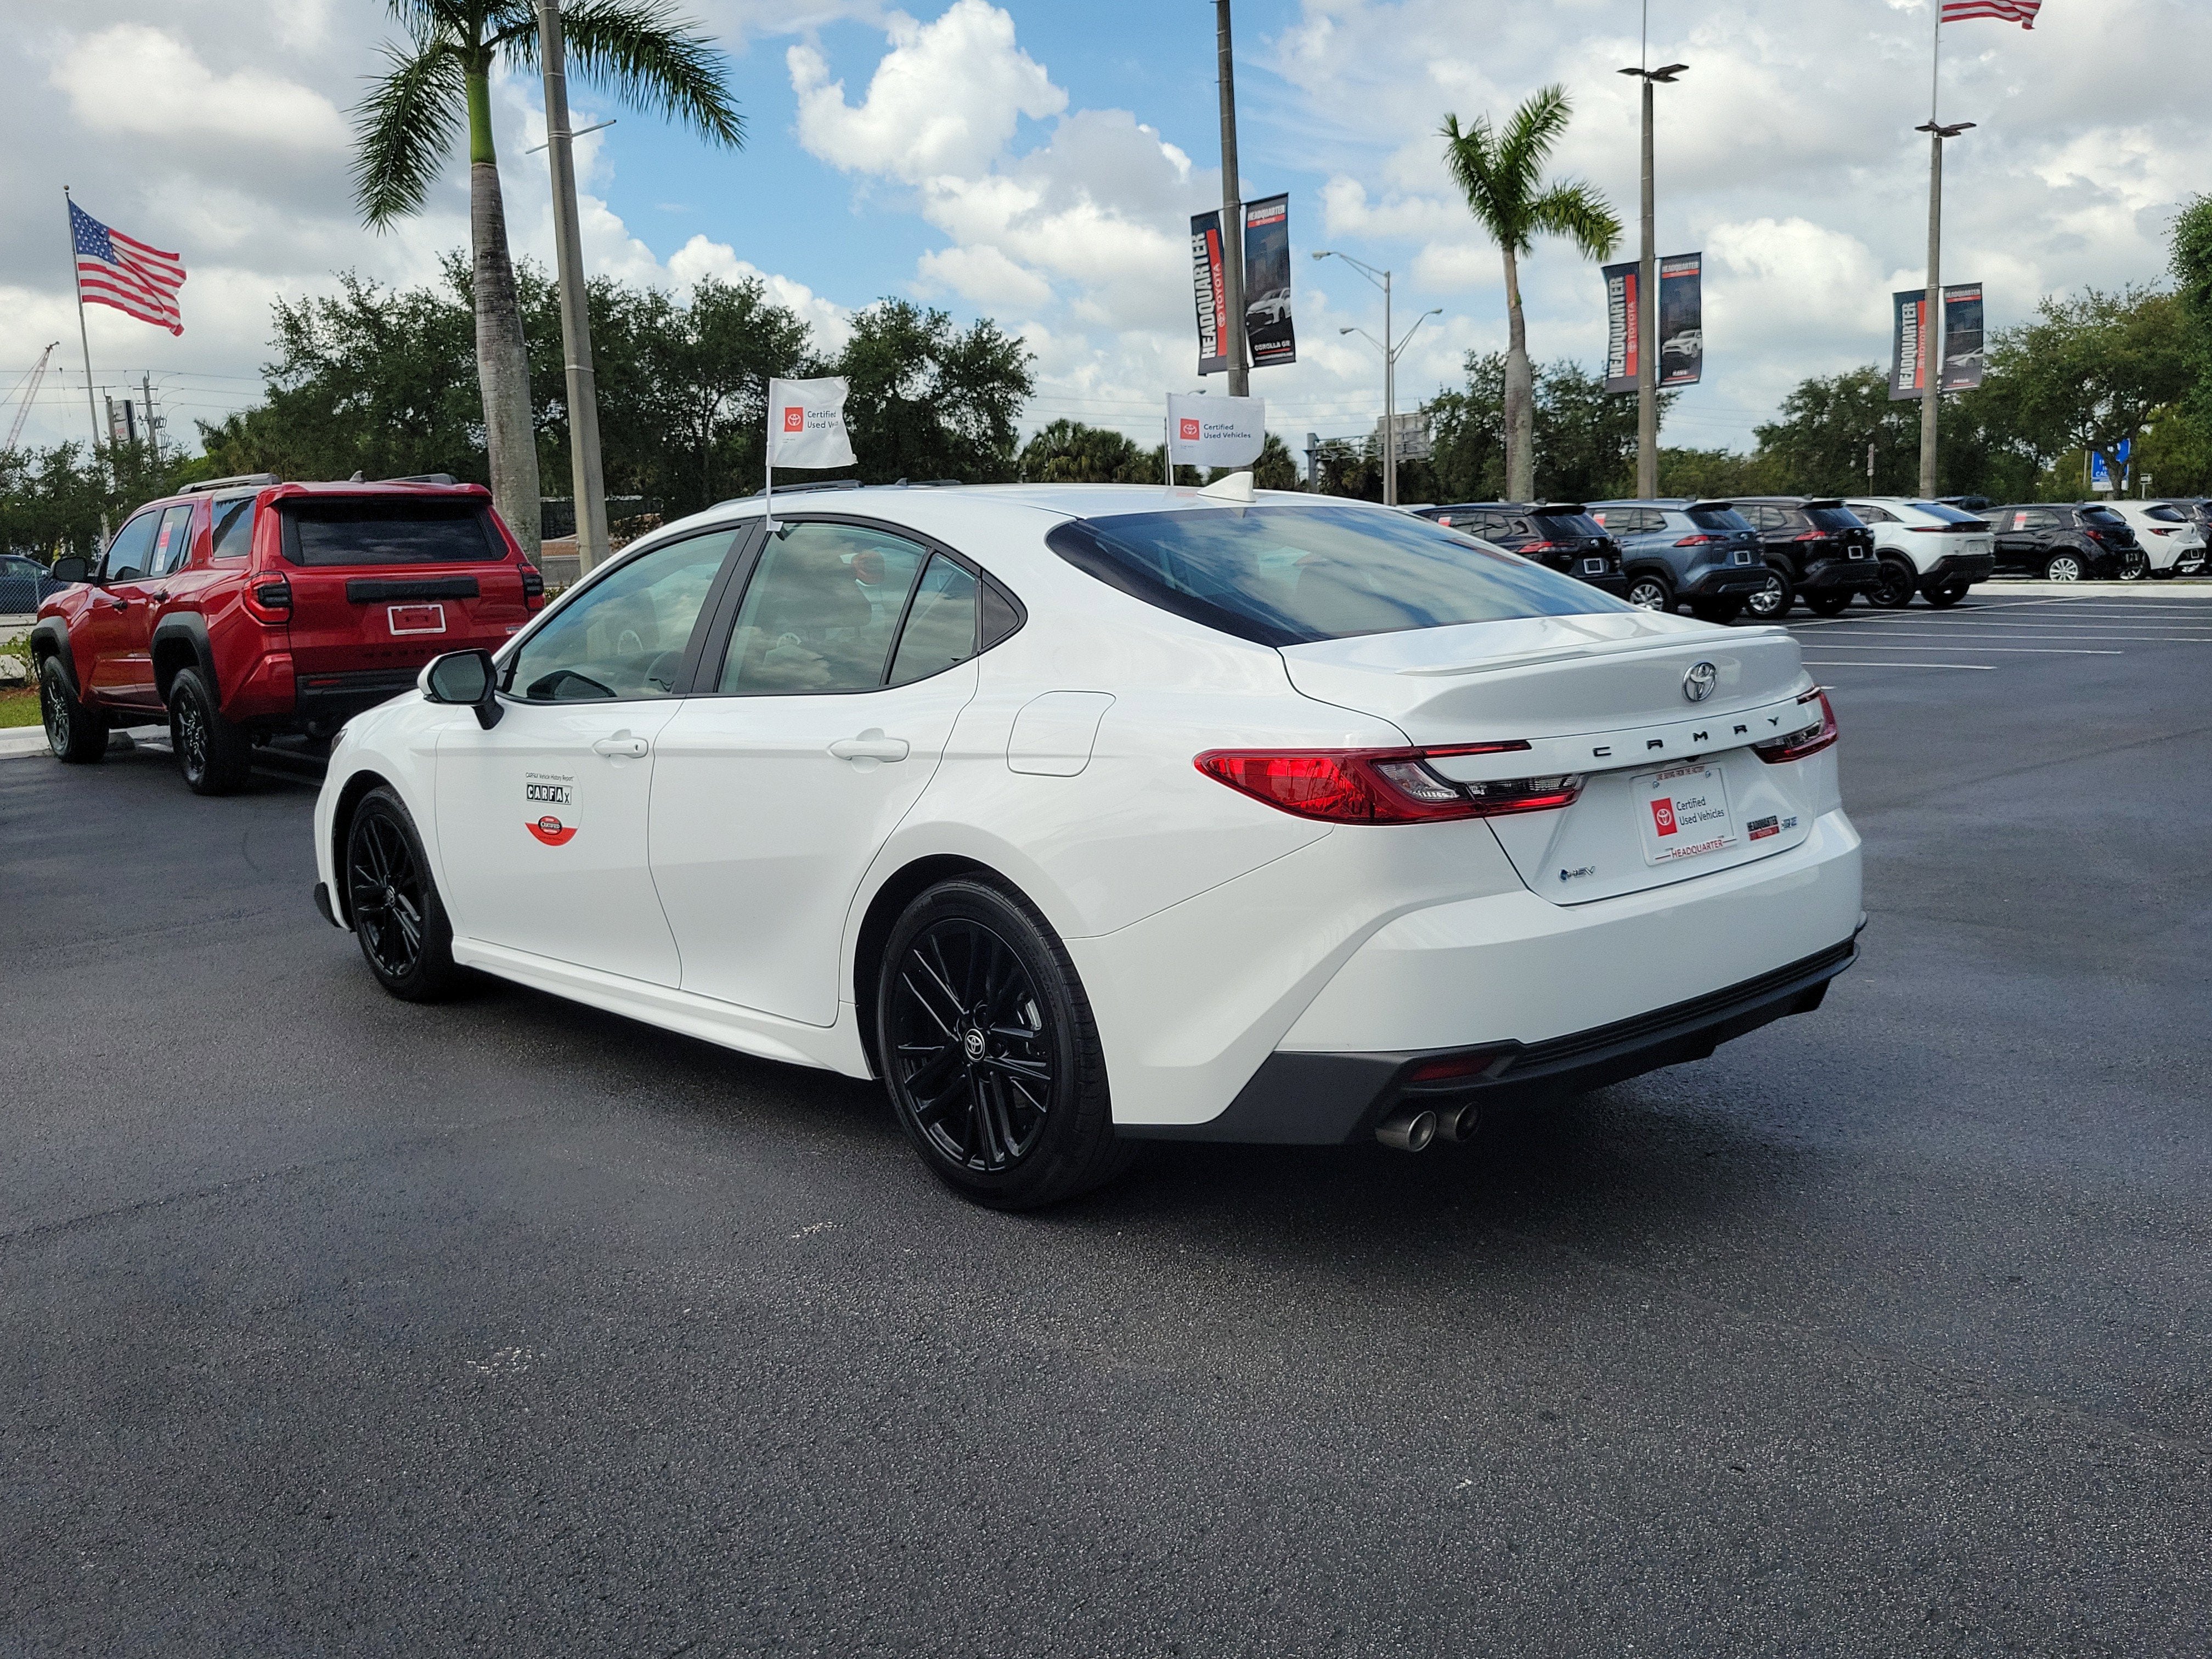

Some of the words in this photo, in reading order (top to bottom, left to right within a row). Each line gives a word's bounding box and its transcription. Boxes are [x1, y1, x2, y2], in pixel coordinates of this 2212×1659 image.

[1191, 232, 1216, 360] HEADQUARTER
[1212, 263, 1225, 312] TOYOTA
[1609, 276, 1626, 379] HEADQUARTER
[1898, 302, 1917, 390] HEADQUARTER
[1592, 715, 1780, 758] CAMRY
[527, 785, 570, 804] CARFAX
[1676, 797, 1706, 811] Certified
[1679, 813, 1697, 826] Used
[1697, 809, 1724, 822] Vehicles
[1671, 839, 1723, 859] HEADQUARTER
